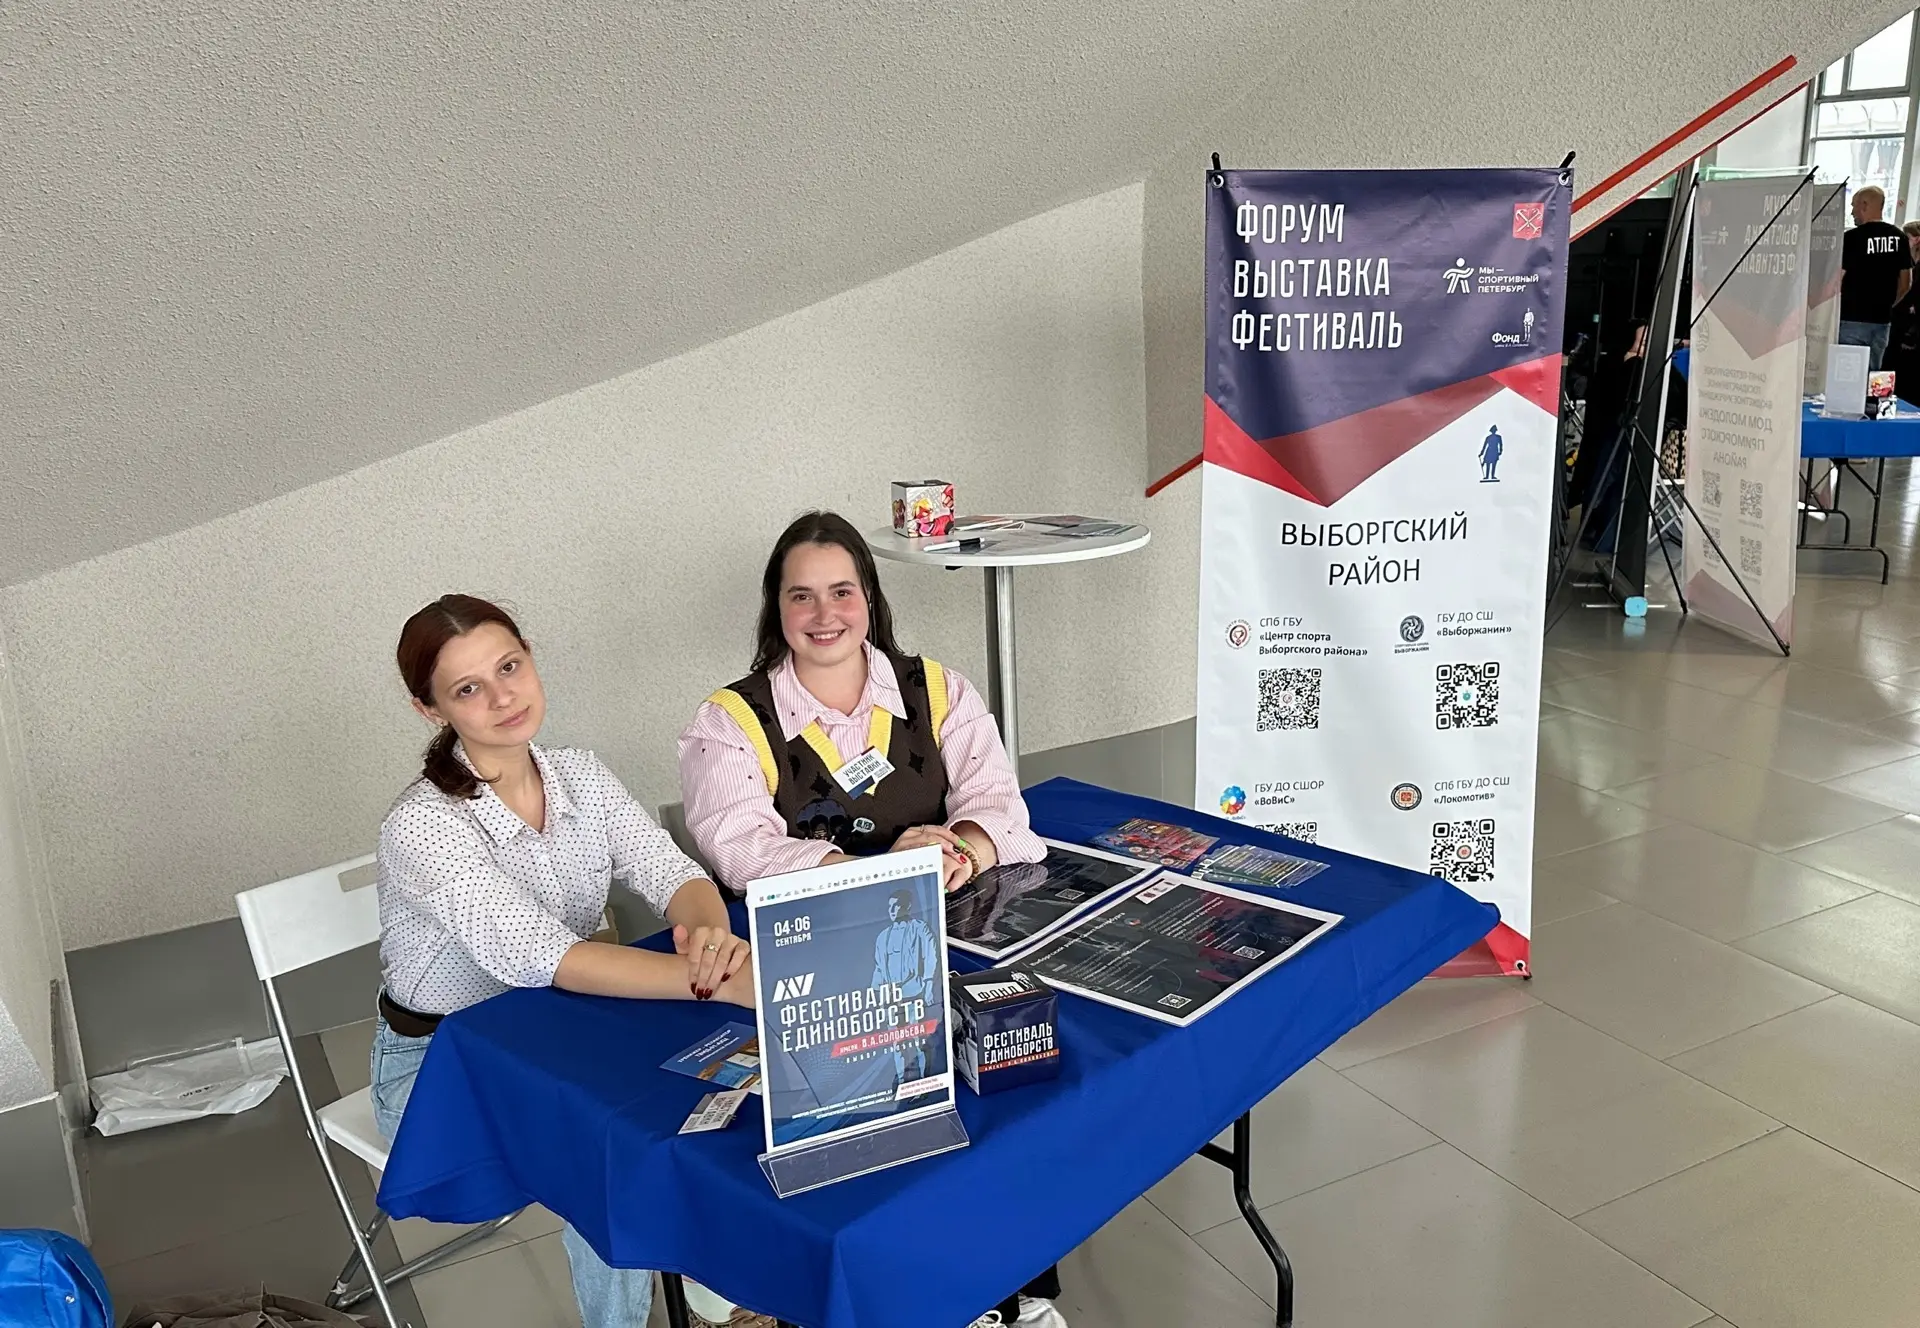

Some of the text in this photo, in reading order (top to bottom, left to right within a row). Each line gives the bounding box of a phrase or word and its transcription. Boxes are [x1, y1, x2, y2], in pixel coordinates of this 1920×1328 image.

[1236, 200, 1346, 244] ФОРУМ
[1866, 236, 1901, 255] АТЛЕТ
[1232, 257, 1391, 299] ВЫСТАВКА
[1478, 274, 1539, 284] СПОРТИВНЫЙ
[1477, 285, 1526, 293] ПЕТЕРБУРГ
[1231, 309, 1403, 352] ФЕСТИВАЛЬ
[1281, 510, 1468, 547] ВЫБОРГСКИЙ
[1328, 555, 1421, 586] РАЙОН
[1259, 617, 1302, 627] СПб ГБУ
[1437, 611, 1494, 623] ГБУ ДО СШ
[1259, 632, 1331, 642] «Центр спорта
[1436, 626, 1512, 637] «Выборжанин»
[1259, 644, 1368, 656] Выборгского района»
[843, 754, 875, 777] УЧАСТНИК
[848, 760, 881, 785] ВЫСТАВКИ
[1255, 780, 1325, 793] ГБУ ДО СШОР
[1434, 777, 1510, 791] СПб ГБУ ДО СШ
[1254, 795, 1295, 806] «ВоВиС»
[1433, 792, 1495, 804] «Локомотив»
[775, 932, 812, 948] СЕНТЯБРЯ
[780, 981, 903, 1028] ФЕСТИВАЛЬ
[782, 999, 925, 1053] ЕДИНОБОРСТВ
[983, 1022, 1053, 1050] ФЕСТИВАЛЬ
[984, 1036, 1054, 1065] ЕДИНОБОРСТВ
